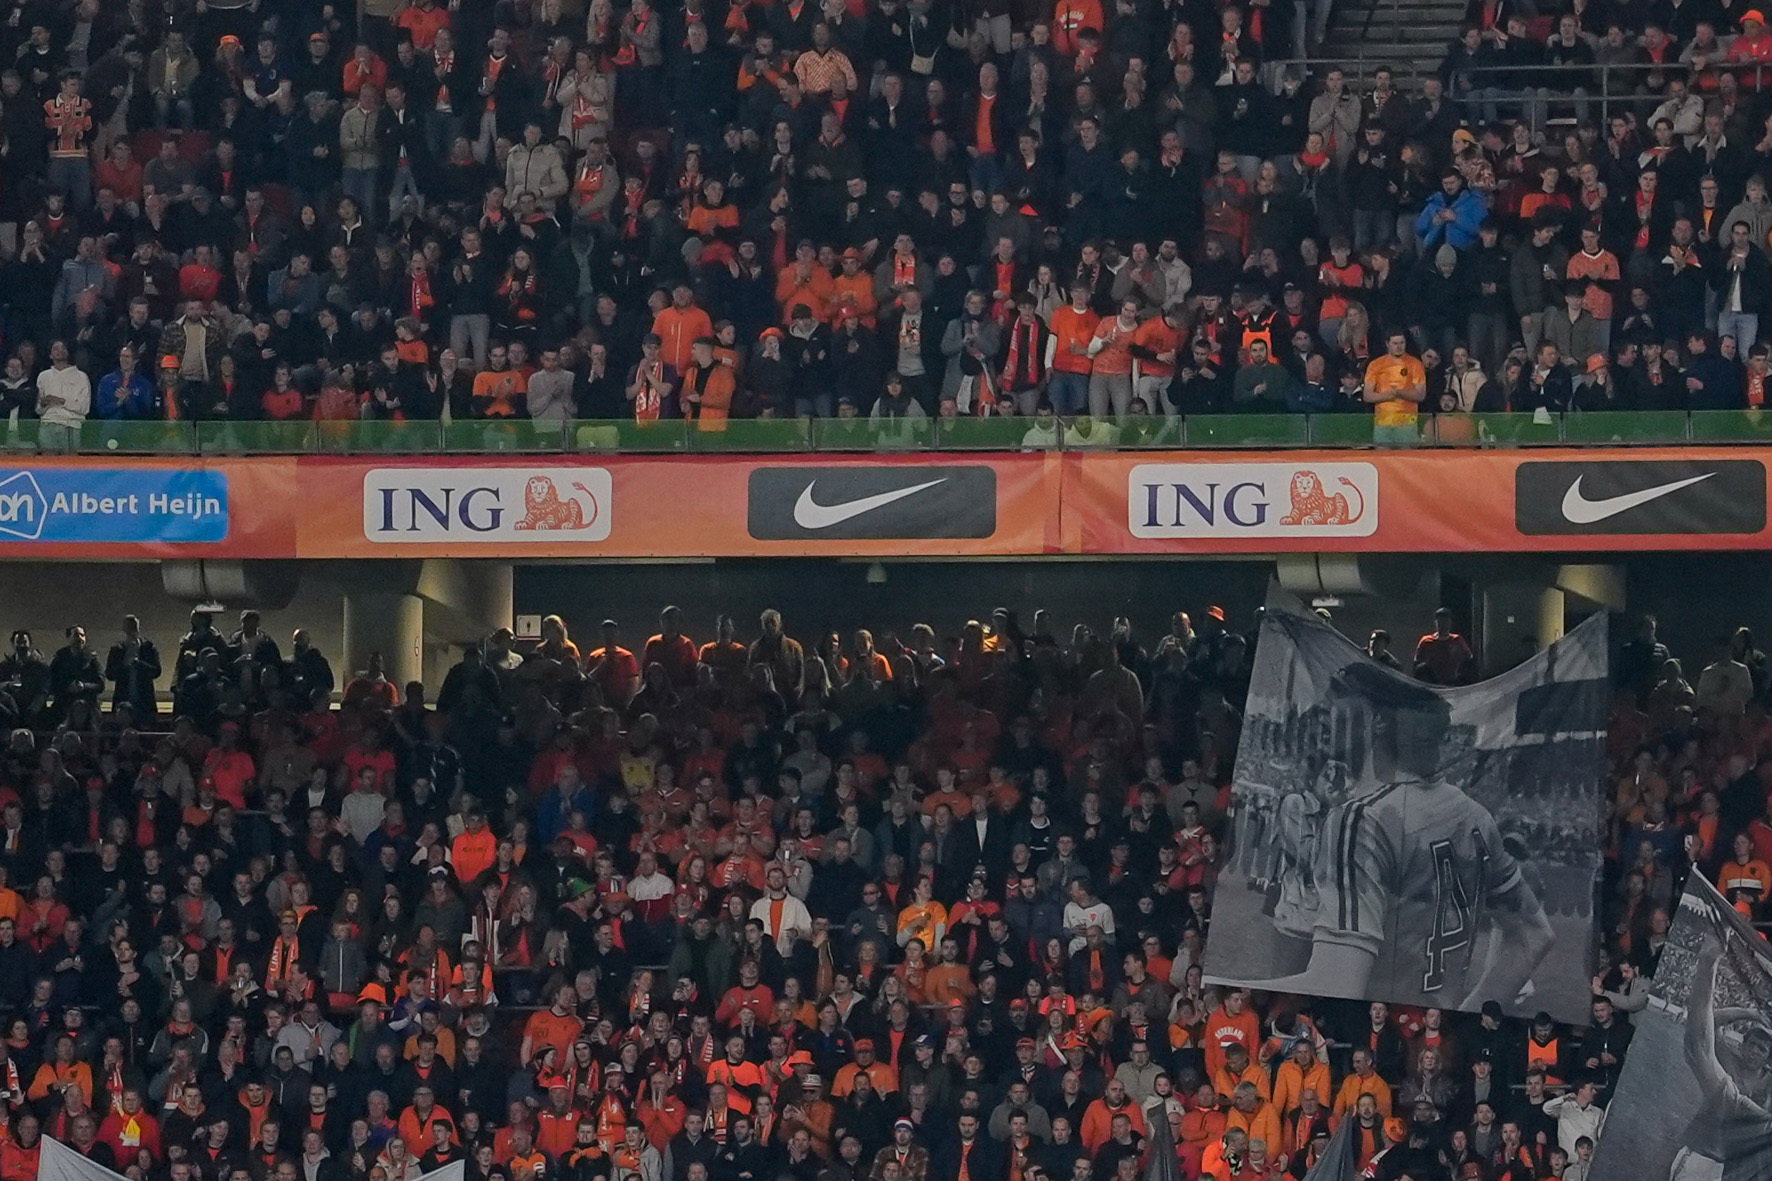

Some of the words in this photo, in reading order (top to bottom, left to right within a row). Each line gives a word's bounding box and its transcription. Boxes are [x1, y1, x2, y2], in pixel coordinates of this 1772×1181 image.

[51, 492, 138, 515] Albert
[149, 493, 220, 520] Heijn
[378, 488, 504, 532] ING
[1142, 482, 1269, 527] ING
